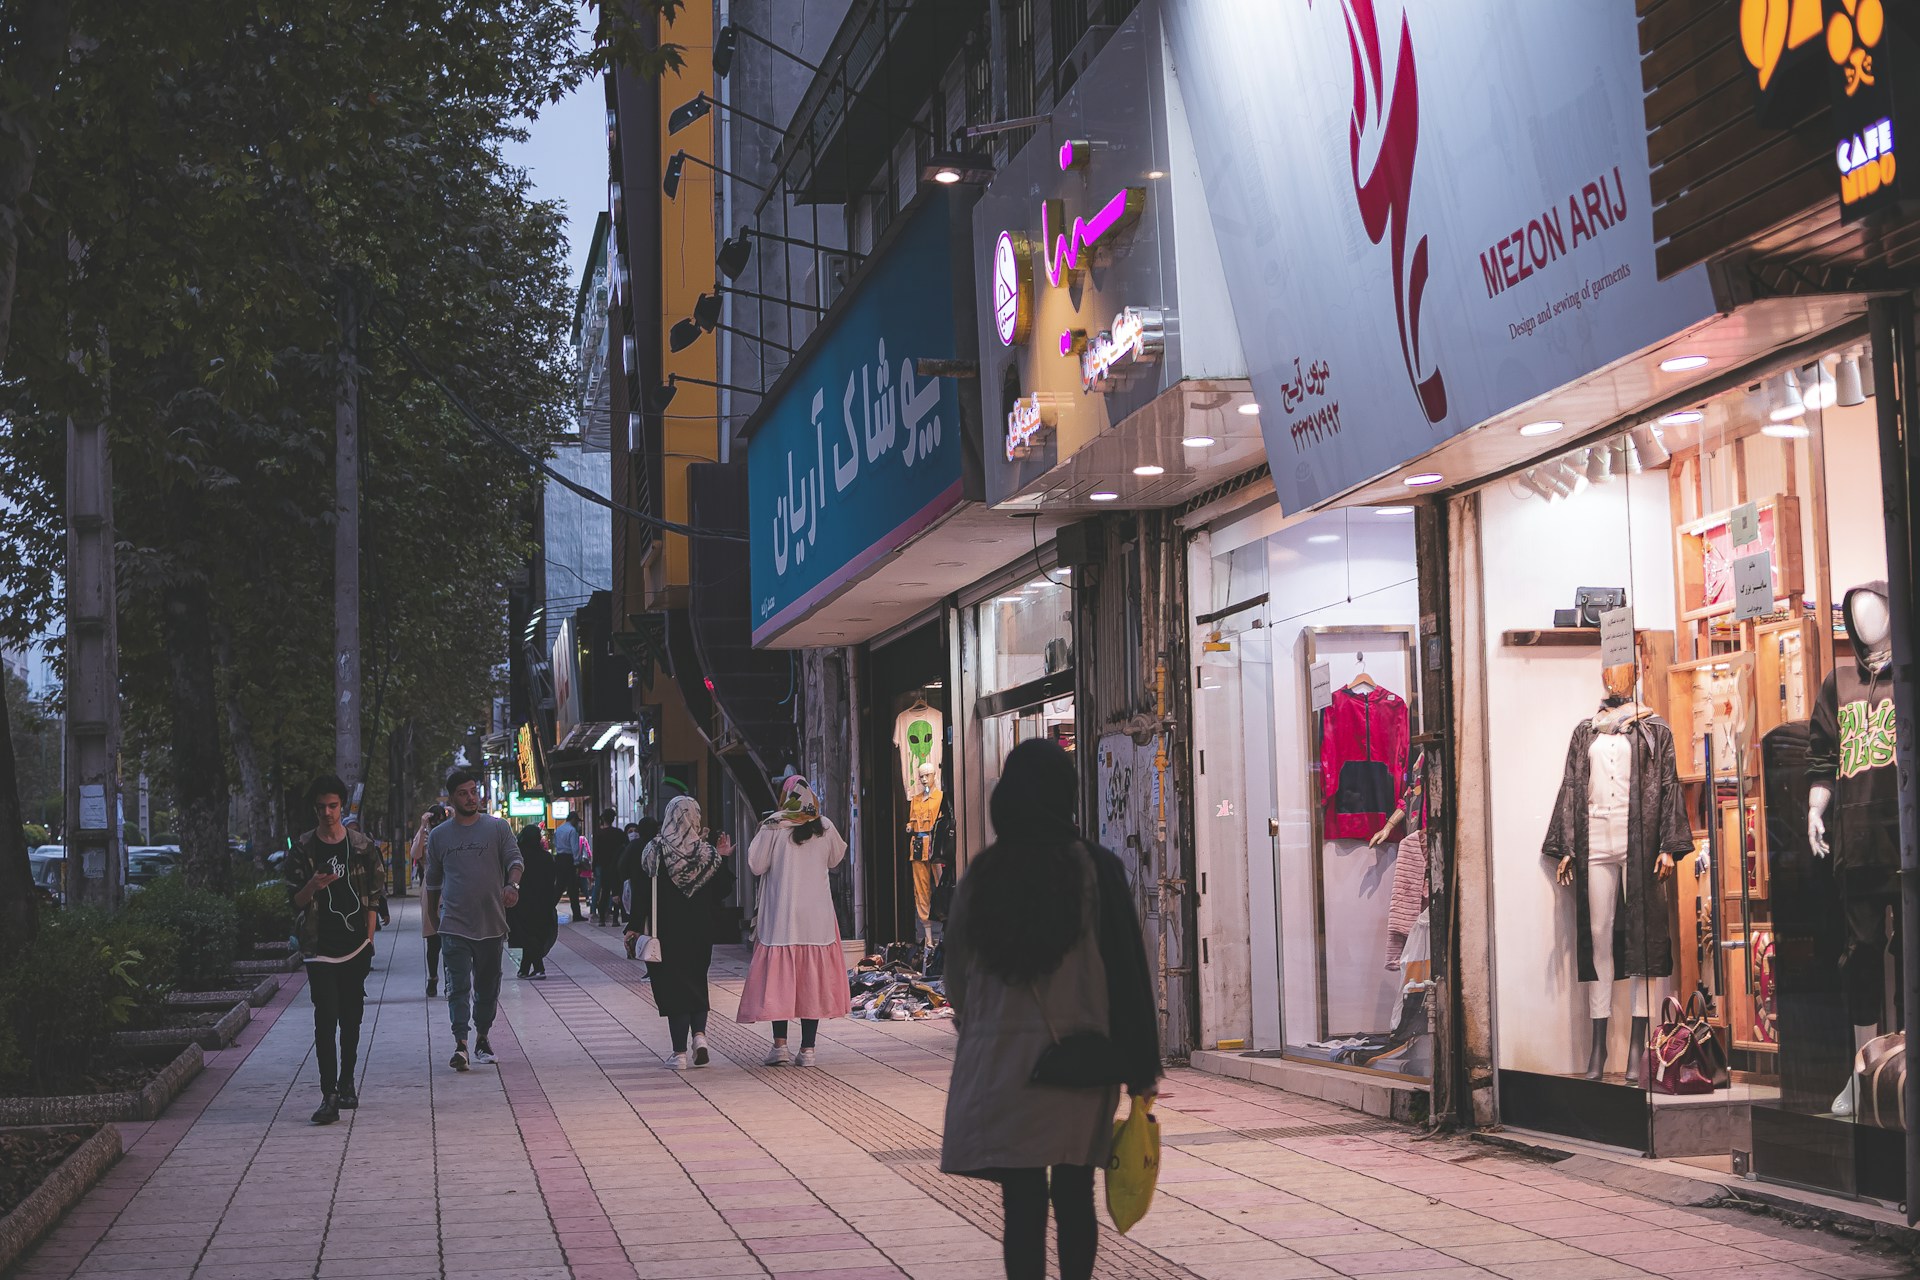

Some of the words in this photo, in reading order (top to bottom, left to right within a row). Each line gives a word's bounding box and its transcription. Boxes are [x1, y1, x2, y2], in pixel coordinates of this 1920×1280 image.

[1837, 116, 1894, 175] CAFE
[1841, 152, 1896, 206] NIDO
[1480, 205, 1567, 299] MEZON
[1569, 166, 1627, 249] ARIJ
[1508, 317, 1537, 340] Design
[1537, 302, 1553, 325] and
[1552, 291, 1583, 316] sewing
[1581, 279, 1591, 300] of
[1591, 263, 1631, 300] garments
[1304, 359, 1330, 396] مزون
[833, 337, 941, 493] پوشاک
[773, 386, 826, 576] آریان
[1740, 583, 1752, 596] بزرگ
[1752, 579, 1767, 594] سایز
